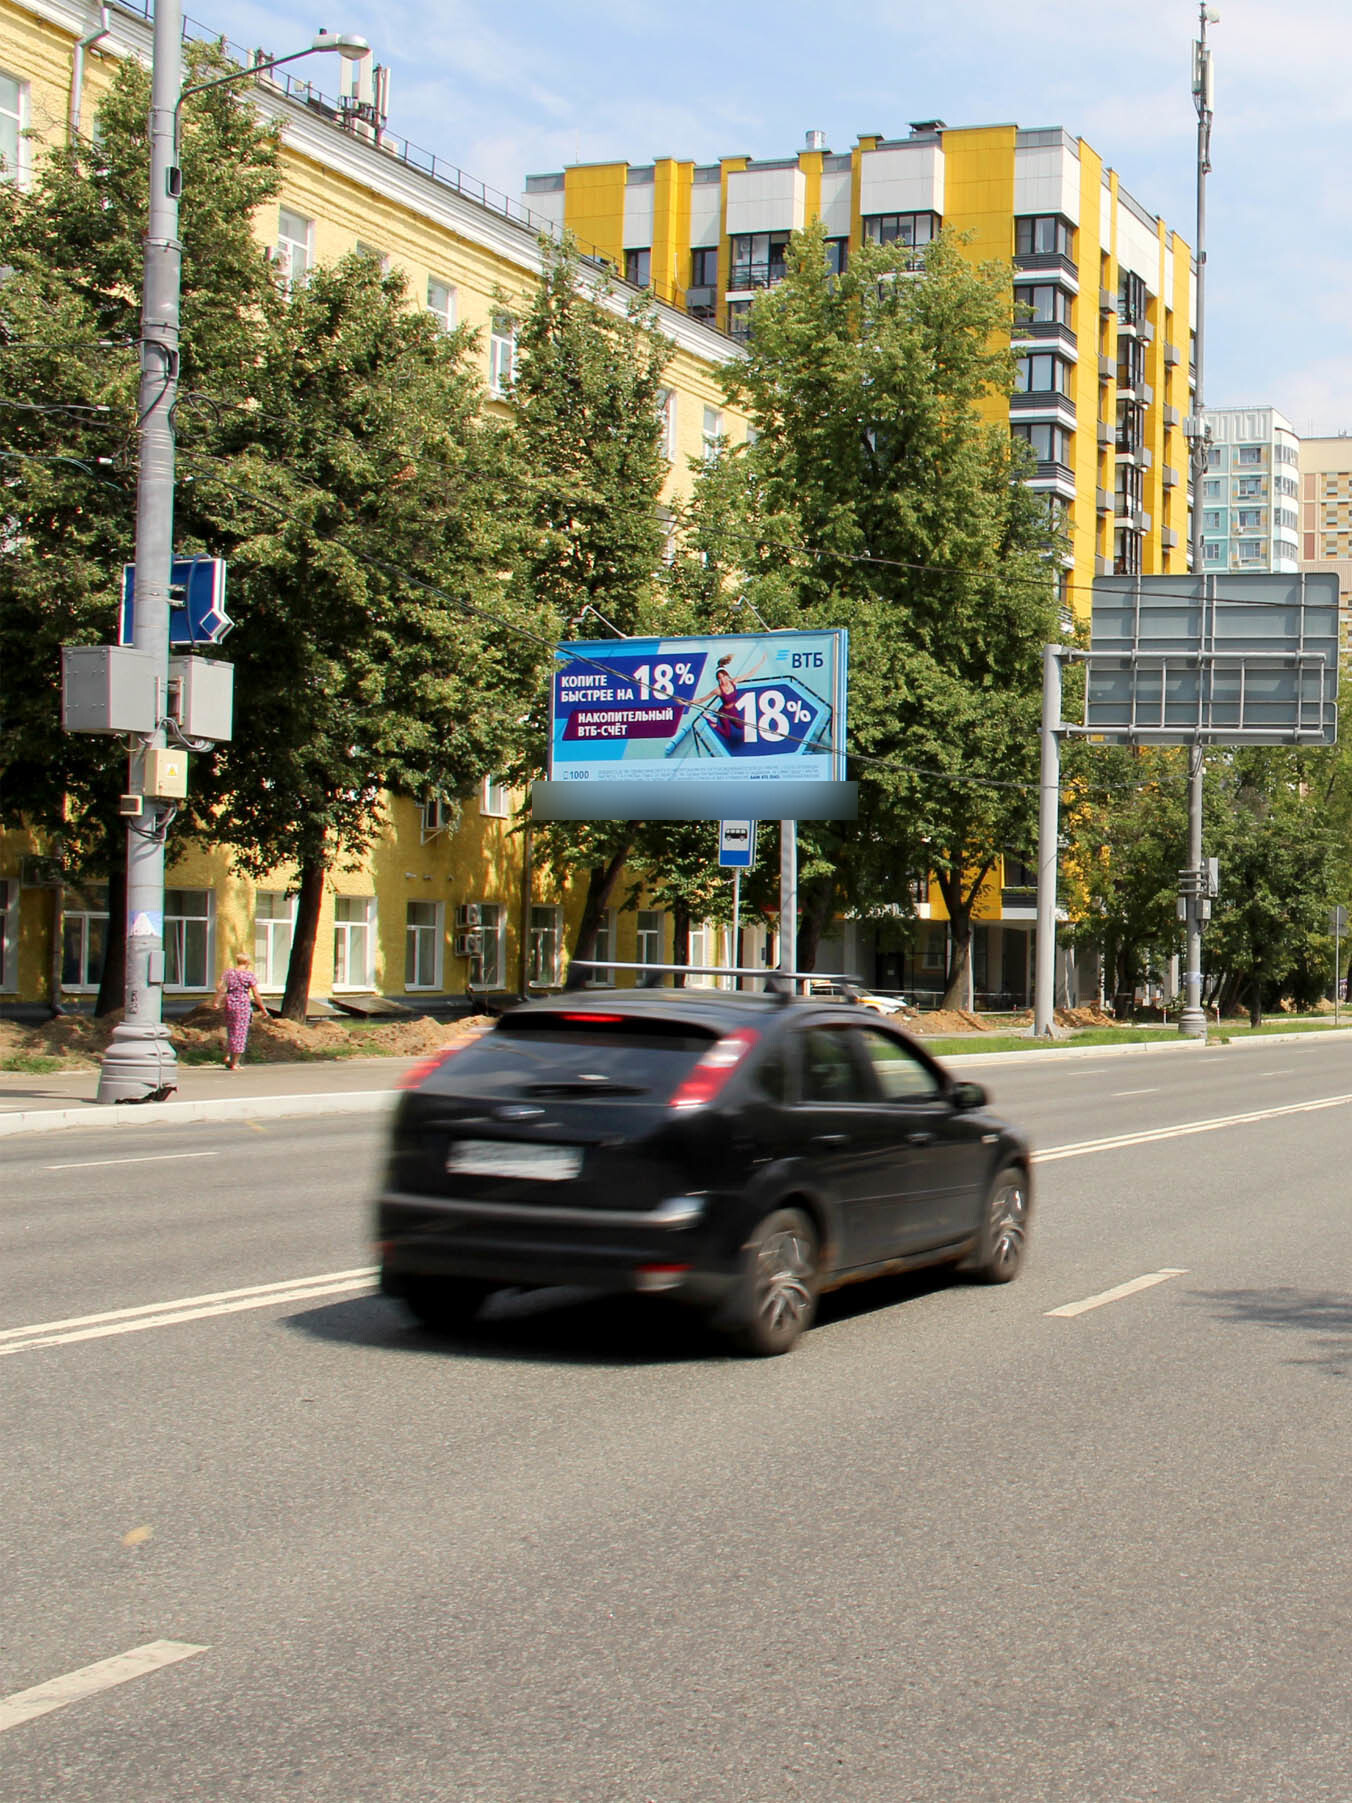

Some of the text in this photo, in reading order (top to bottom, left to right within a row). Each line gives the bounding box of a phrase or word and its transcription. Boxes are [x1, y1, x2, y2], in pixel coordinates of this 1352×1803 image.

[792, 652, 824, 669] ВТБ
[560, 663, 695, 703] БЫСТРЕЕ НА 18%
[561, 674, 608, 688] КОПИТЕ
[577, 707, 674, 724] НАКОПИТЕЛЬНЫЙ
[735, 690, 812, 743] 18%
[577, 722, 628, 737] ВТБ-СЧЁТ
[569, 770, 590, 780] 1000
